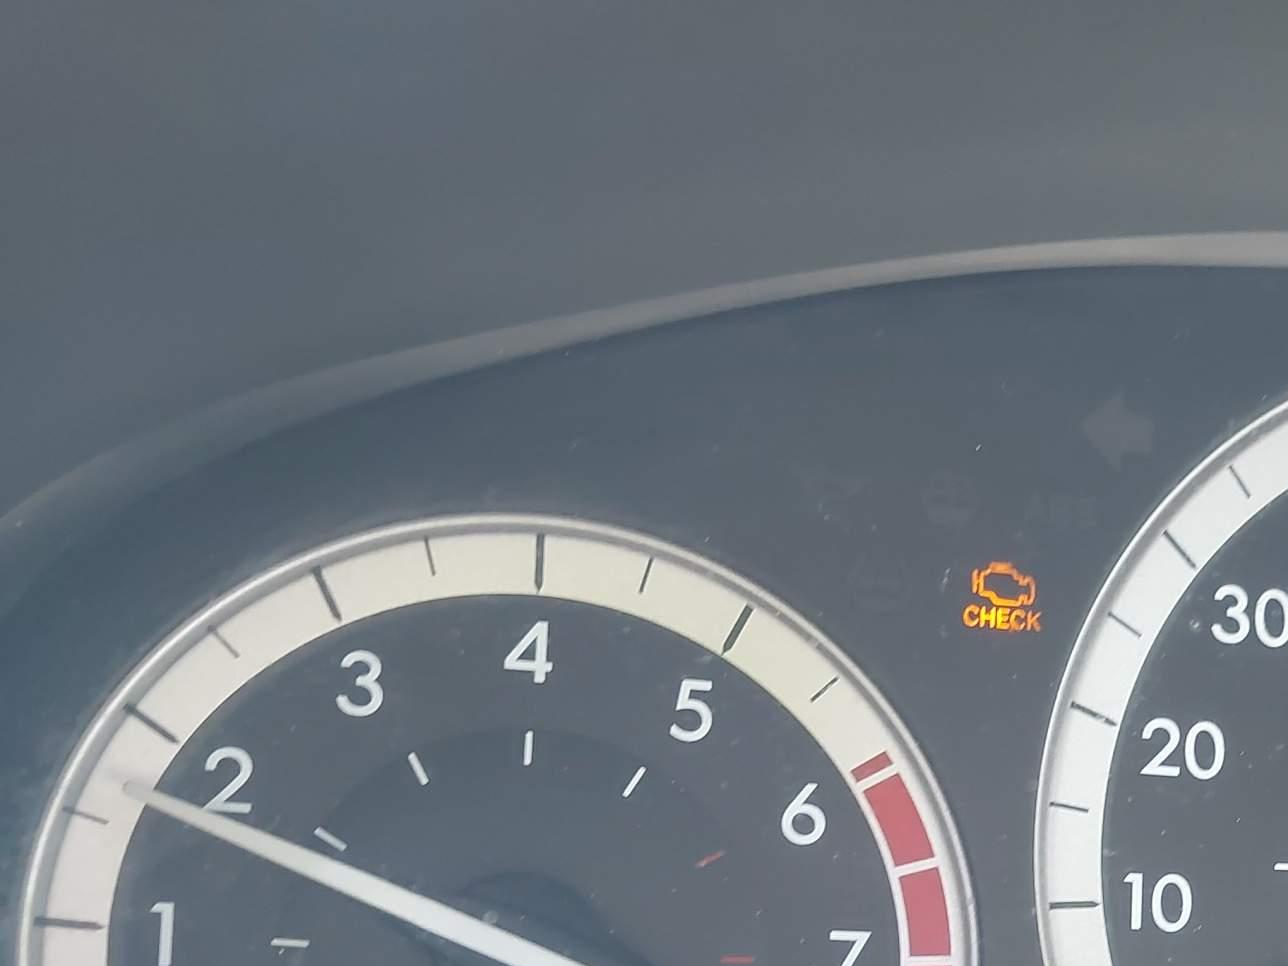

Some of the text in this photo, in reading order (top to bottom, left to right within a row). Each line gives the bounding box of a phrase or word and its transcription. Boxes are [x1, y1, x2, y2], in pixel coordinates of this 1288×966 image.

[961, 605, 1043, 632] CHECK
[335, 649, 384, 717] 3
[503, 621, 553, 684] 4
[669, 678, 713, 742] 5
[202, 747, 253, 813] 2
[1140, 717, 1225, 780] 20
[781, 783, 826, 846] 6
[1123, 872, 1193, 933] 10
